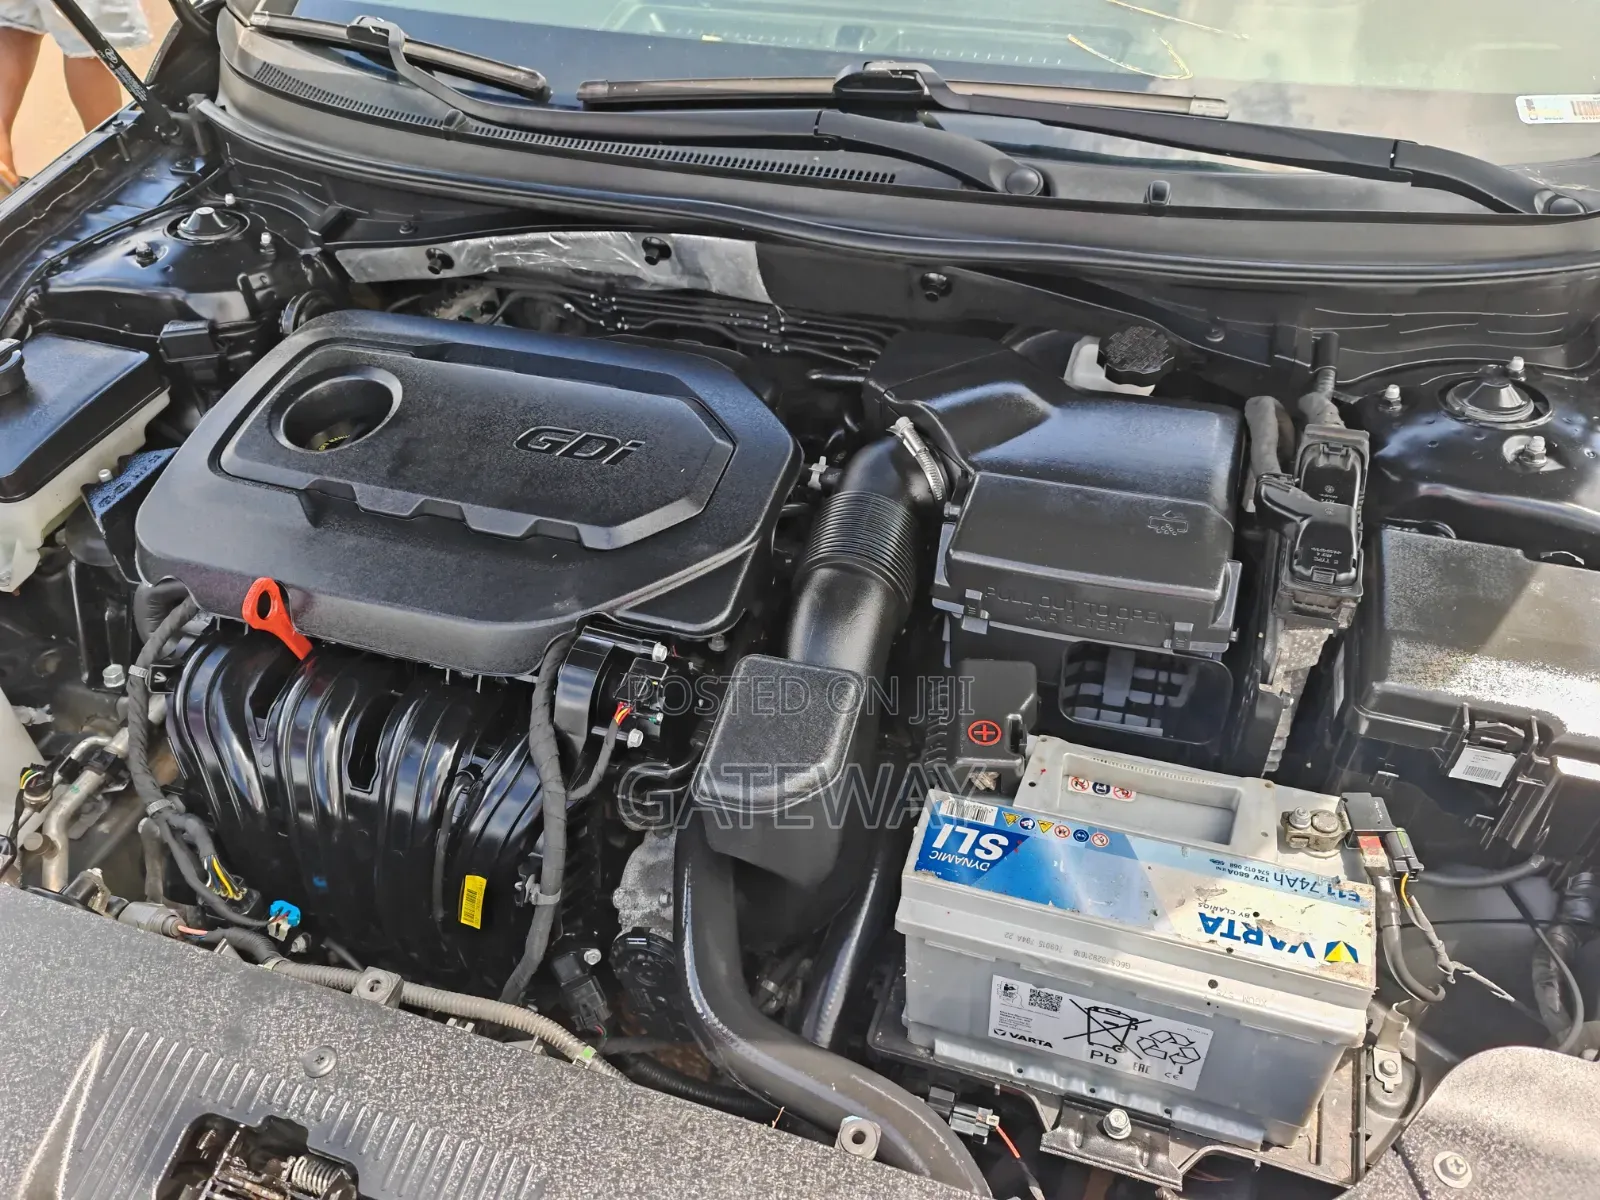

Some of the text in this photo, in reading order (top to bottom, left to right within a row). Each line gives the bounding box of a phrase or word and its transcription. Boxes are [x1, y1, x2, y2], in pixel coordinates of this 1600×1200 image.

[513, 425, 646, 465] GDi
[932, 823, 1009, 861] SLI
[929, 850, 991, 872] DYNAMIC
[1253, 875, 1270, 883] 12V
[1273, 872, 1320, 894] 74Ah
[1010, 1031, 1053, 1049] VARTA
[1089, 1049, 1118, 1066] Pb
[1132, 1061, 1152, 1075] EAC
